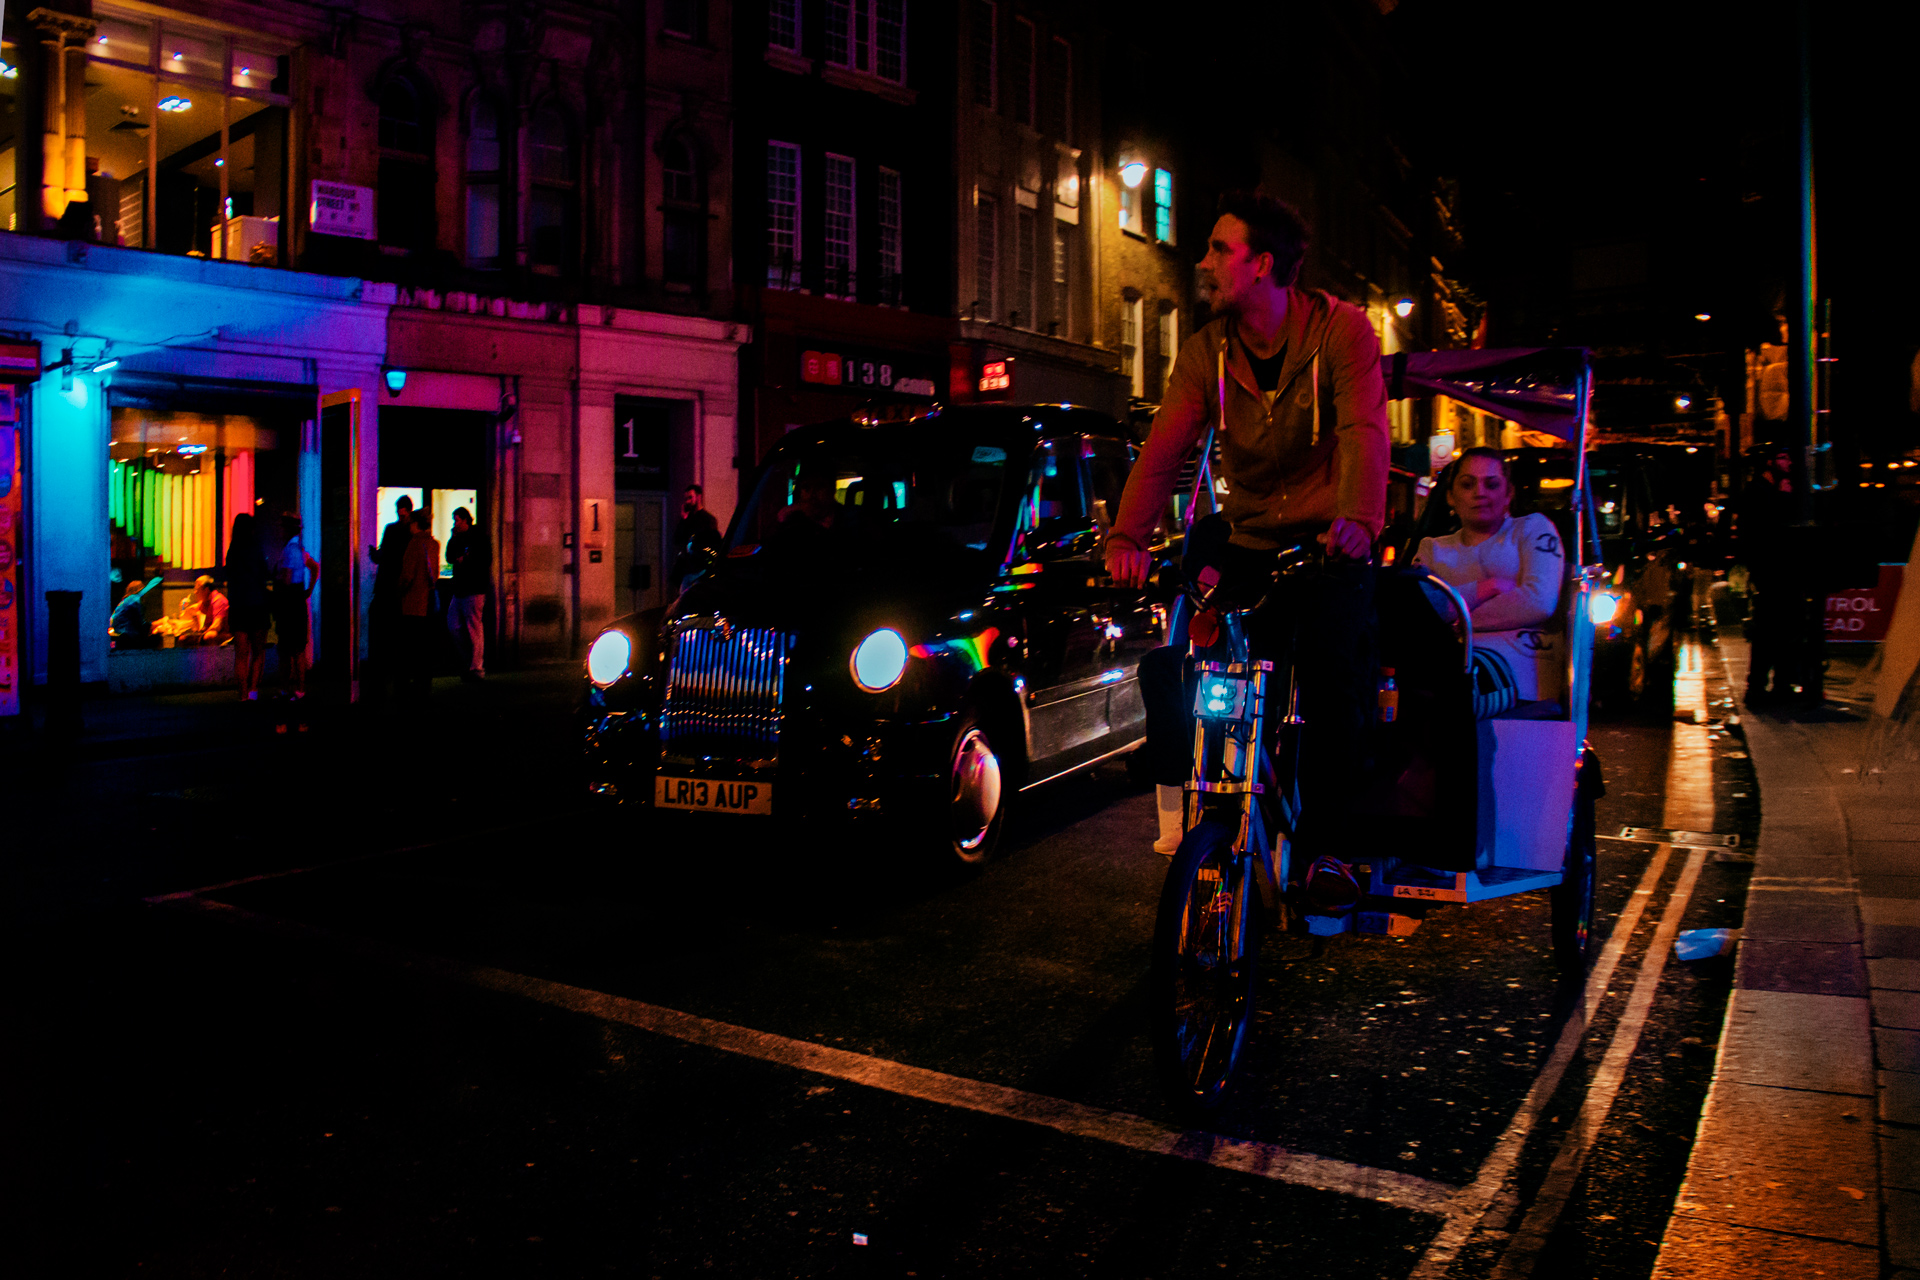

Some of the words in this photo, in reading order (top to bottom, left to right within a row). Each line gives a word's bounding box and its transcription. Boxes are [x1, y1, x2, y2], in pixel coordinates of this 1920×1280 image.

[846, 361, 892, 387] 138
[622, 417, 640, 458] 1
[591, 502, 599, 532] 1
[1825, 597, 1880, 612] TROL
[1823, 617, 1865, 631] EAD
[664, 779, 708, 806] LR13
[715, 783, 758, 809] AUP
